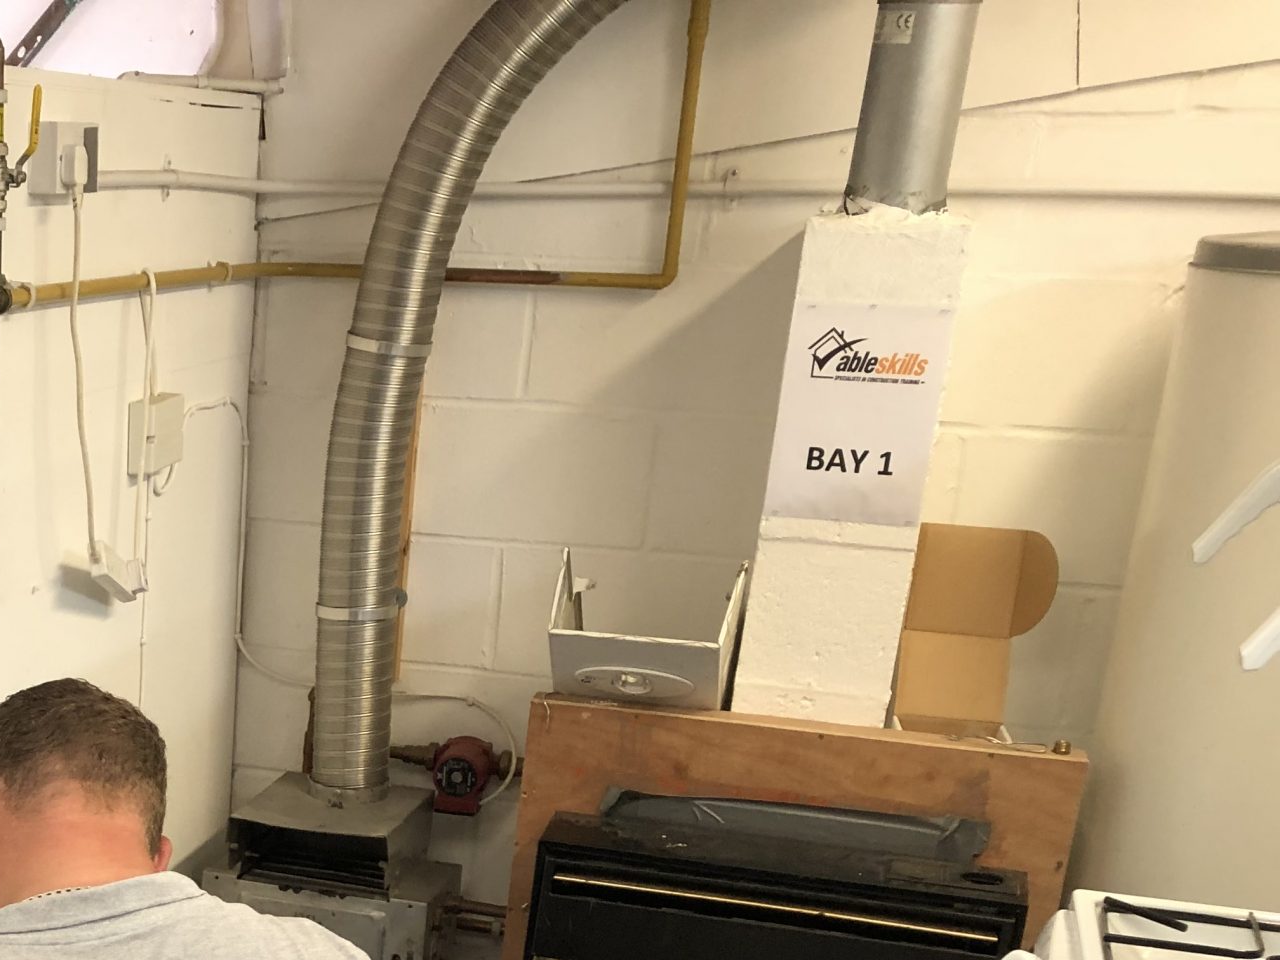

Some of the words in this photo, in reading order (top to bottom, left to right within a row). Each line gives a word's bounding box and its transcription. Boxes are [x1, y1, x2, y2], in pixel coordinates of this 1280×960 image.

[835, 350, 929, 377] ableskills
[806, 446, 870, 474] BAY
[877, 451, 894, 476] 1
